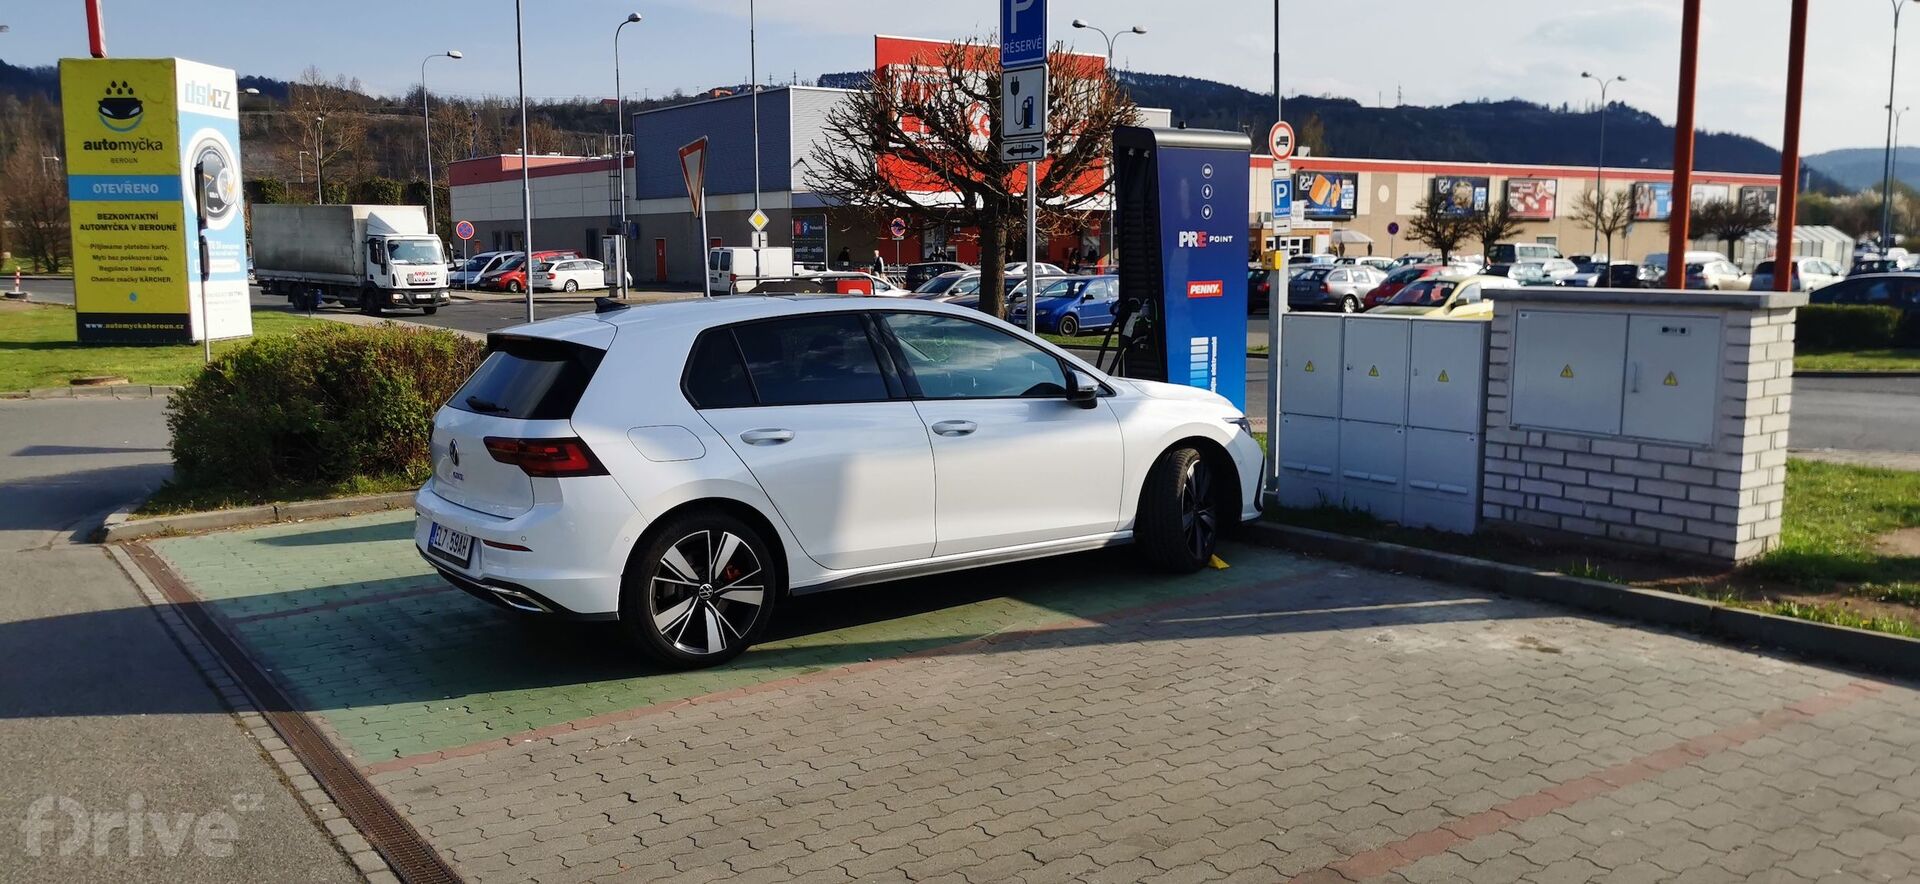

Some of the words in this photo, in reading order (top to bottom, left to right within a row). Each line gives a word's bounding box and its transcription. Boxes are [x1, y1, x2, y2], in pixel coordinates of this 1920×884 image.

[1004, 35, 1042, 54] RÉSERVÉ
[83, 137, 163, 153] automyčka
[92, 181, 159, 194] OTEVŘENO
[1276, 183, 1288, 206] P
[80, 223, 129, 231] AUTOMYČKA
[1179, 231, 1207, 248] PRE
[1209, 235, 1233, 243] POINT
[85, 322, 184, 330] www.automyckaberoun.cz
